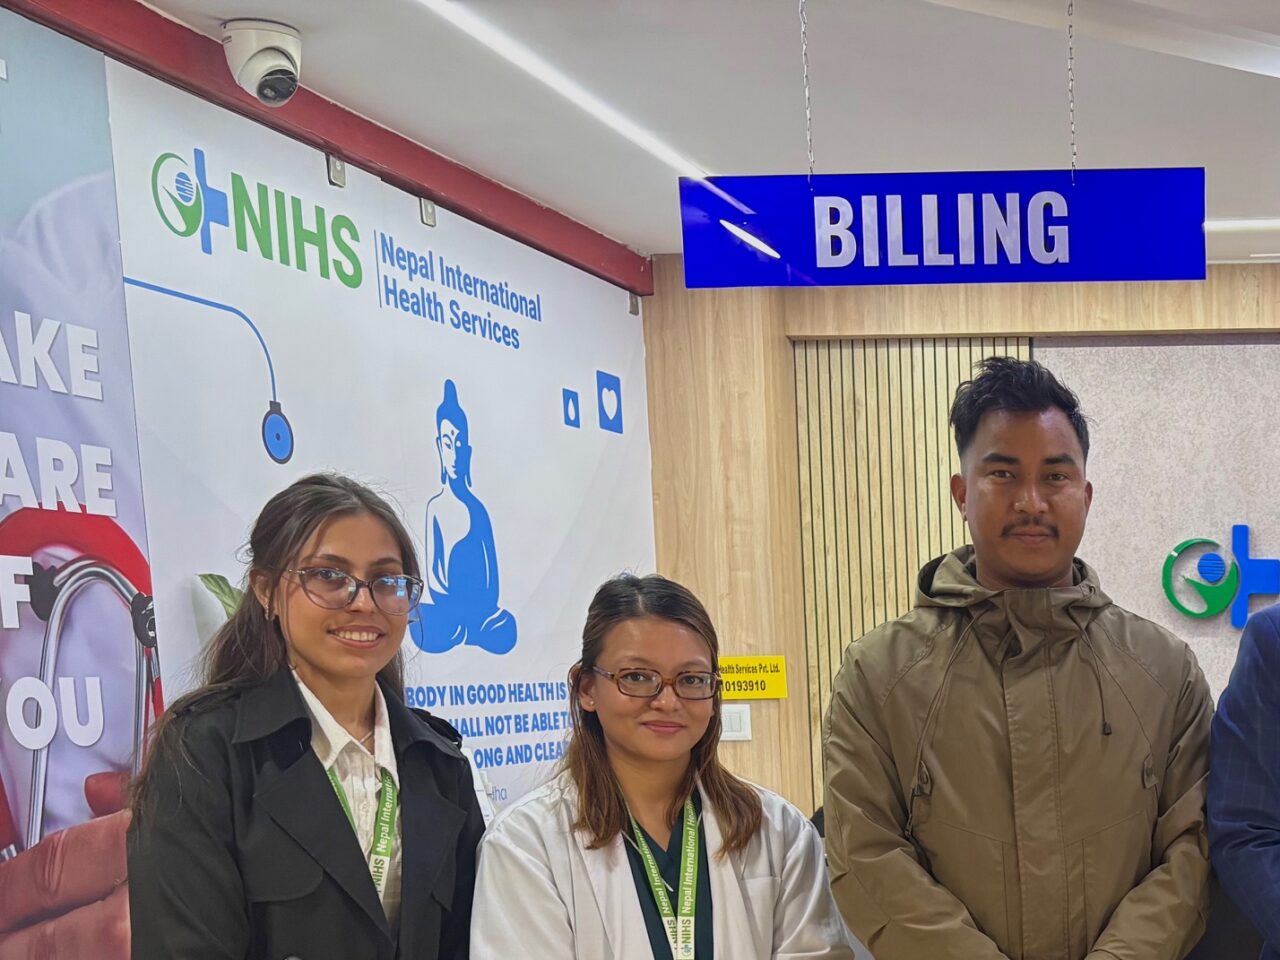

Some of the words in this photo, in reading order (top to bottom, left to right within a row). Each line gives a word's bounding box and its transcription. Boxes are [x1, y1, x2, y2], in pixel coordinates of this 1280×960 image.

[231, 172, 362, 289] NIHS
[813, 190, 1070, 269] BILLING
[380, 232, 435, 282] Nepal
[439, 256, 542, 322] International
[383, 275, 445, 324] Health
[449, 299, 520, 349] Services
[735, 664, 757, 674] Services
[770, 663, 780, 673] Ltd.
[404, 686, 446, 708] BODY
[450, 685, 464, 705] IN
[466, 684, 506, 705] GOOD
[508, 682, 554, 703] HEALTH
[555, 682, 567, 700] IS
[0, 676, 104, 750] OU
[485, 715, 512, 736] NOT
[514, 714, 529, 733] BE
[531, 712, 560, 732] ABLE
[506, 745, 533, 765] AND
[376, 821, 391, 852] Nepal
[683, 826, 697, 885] International
[656, 887, 671, 914] Nepal
[681, 887, 696, 914] Nepal
[681, 919, 692, 944] NIHS
